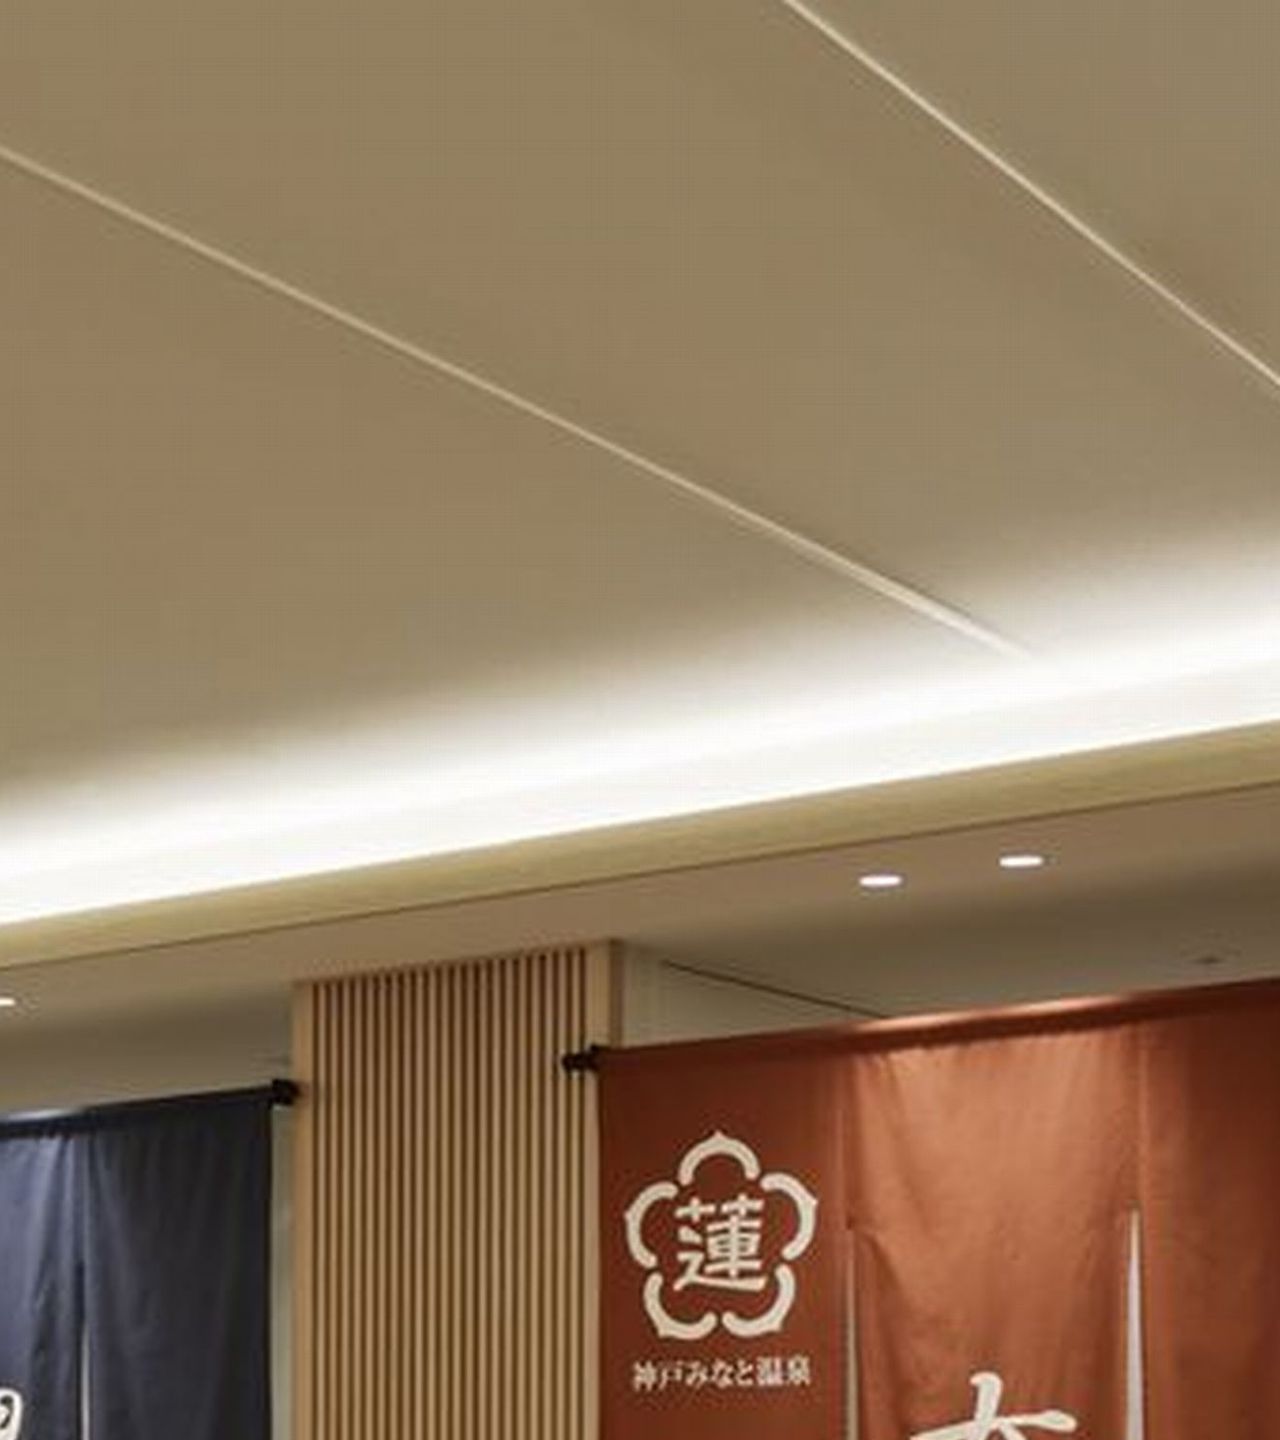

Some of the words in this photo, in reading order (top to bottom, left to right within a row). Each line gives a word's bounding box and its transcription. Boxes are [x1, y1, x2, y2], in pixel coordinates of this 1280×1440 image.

[673, 1193, 768, 1292] 蓮
[633, 1355, 810, 1391] 神戸みなと温泉
